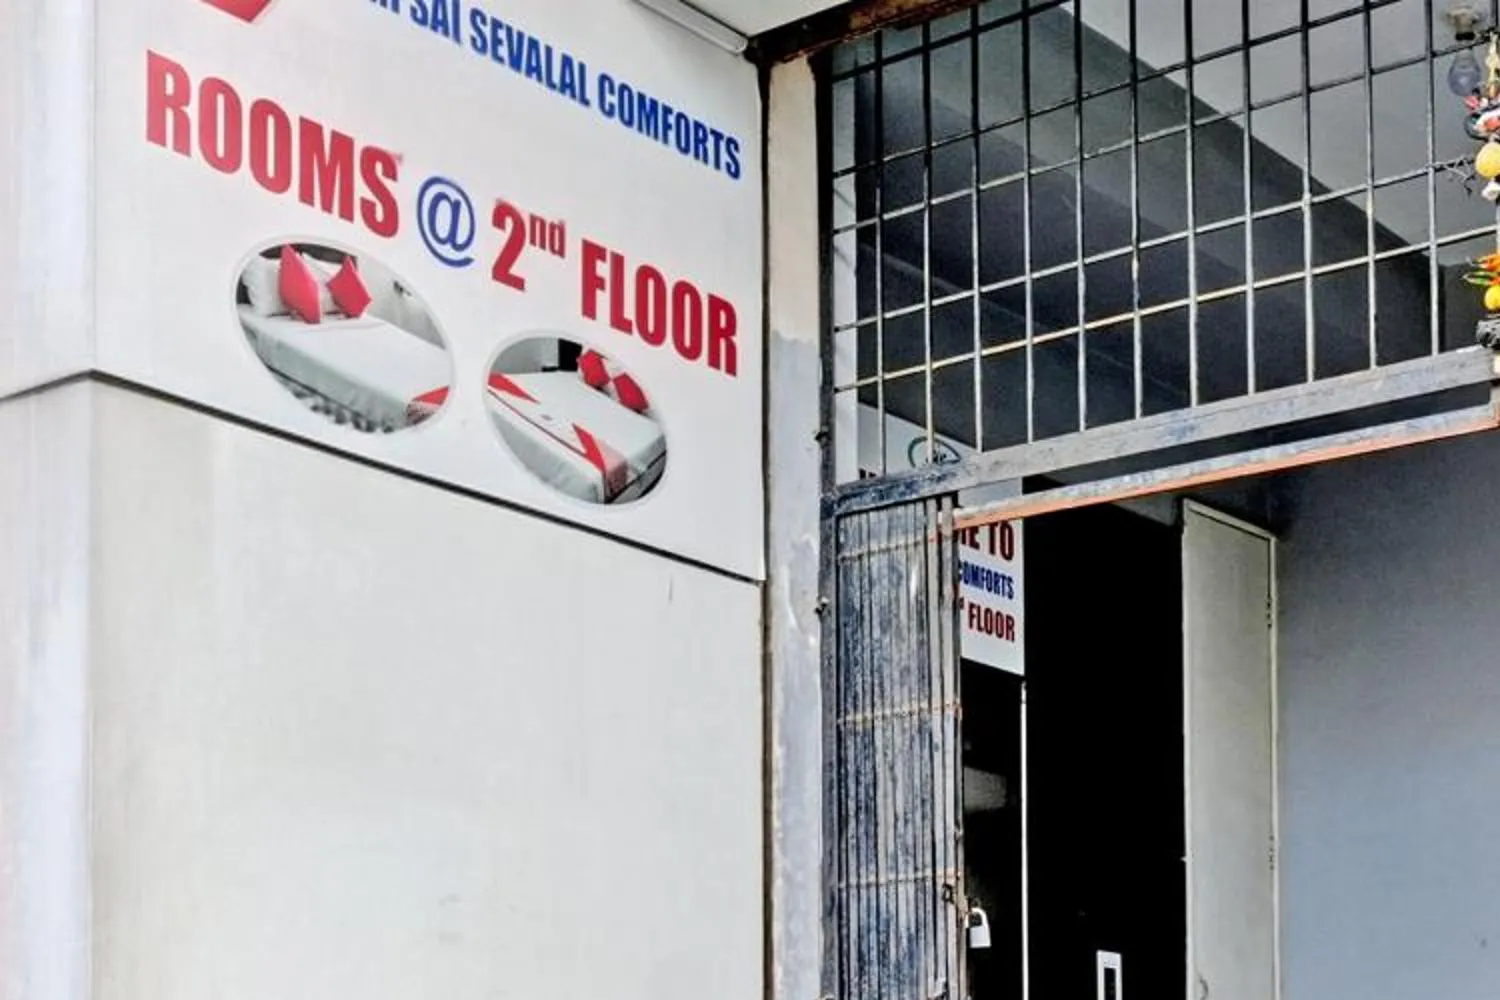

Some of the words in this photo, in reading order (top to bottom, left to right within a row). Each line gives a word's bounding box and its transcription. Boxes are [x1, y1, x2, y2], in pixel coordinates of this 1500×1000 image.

[410, 0, 462, 44] SAI
[470, 7, 590, 107] SEVALAL
[598, 73, 741, 180] COMFORTS
[146, 49, 399, 238] ROOMS
[417, 176, 476, 268] @
[491, 198, 566, 292] 2nd
[581, 238, 738, 377] FLOOR
[989, 521, 1014, 562] TO
[968, 601, 1015, 643] FLOOR
